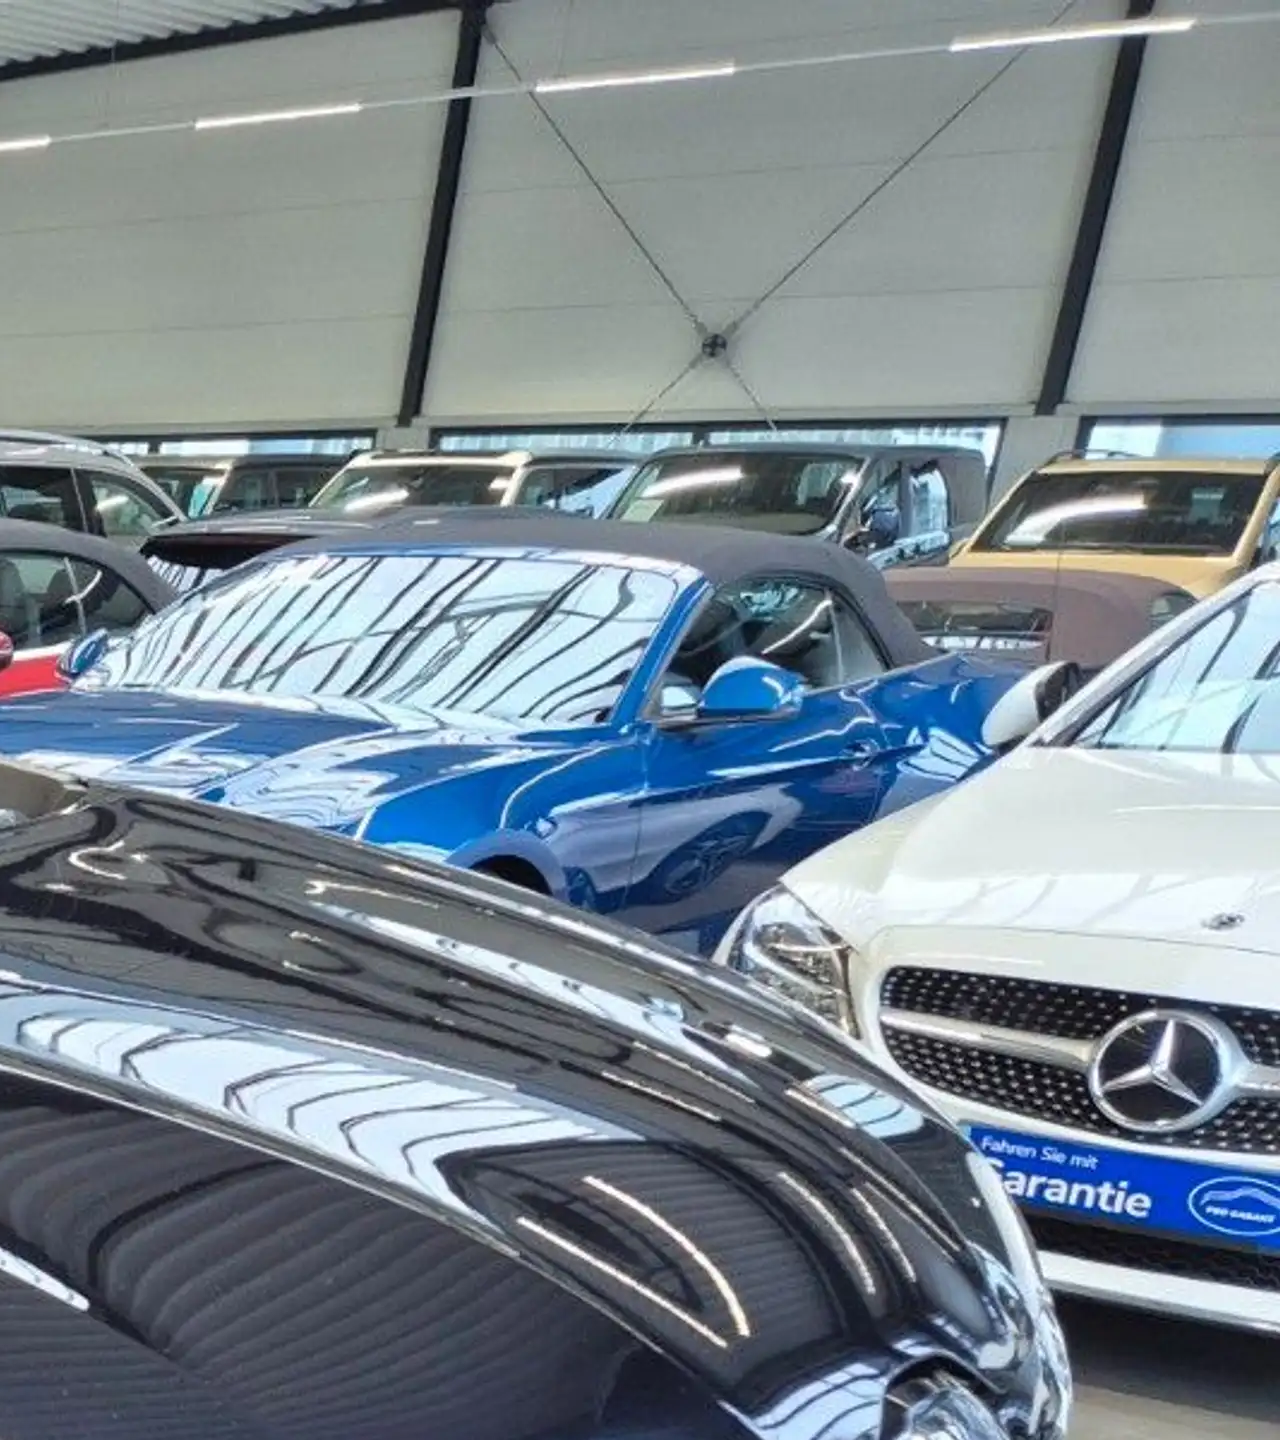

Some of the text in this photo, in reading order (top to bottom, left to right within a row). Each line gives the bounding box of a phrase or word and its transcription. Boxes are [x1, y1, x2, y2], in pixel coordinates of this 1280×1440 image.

[982, 1135, 1099, 1170] Fahren Sie mit
[987, 1156, 1153, 1218] arantie
